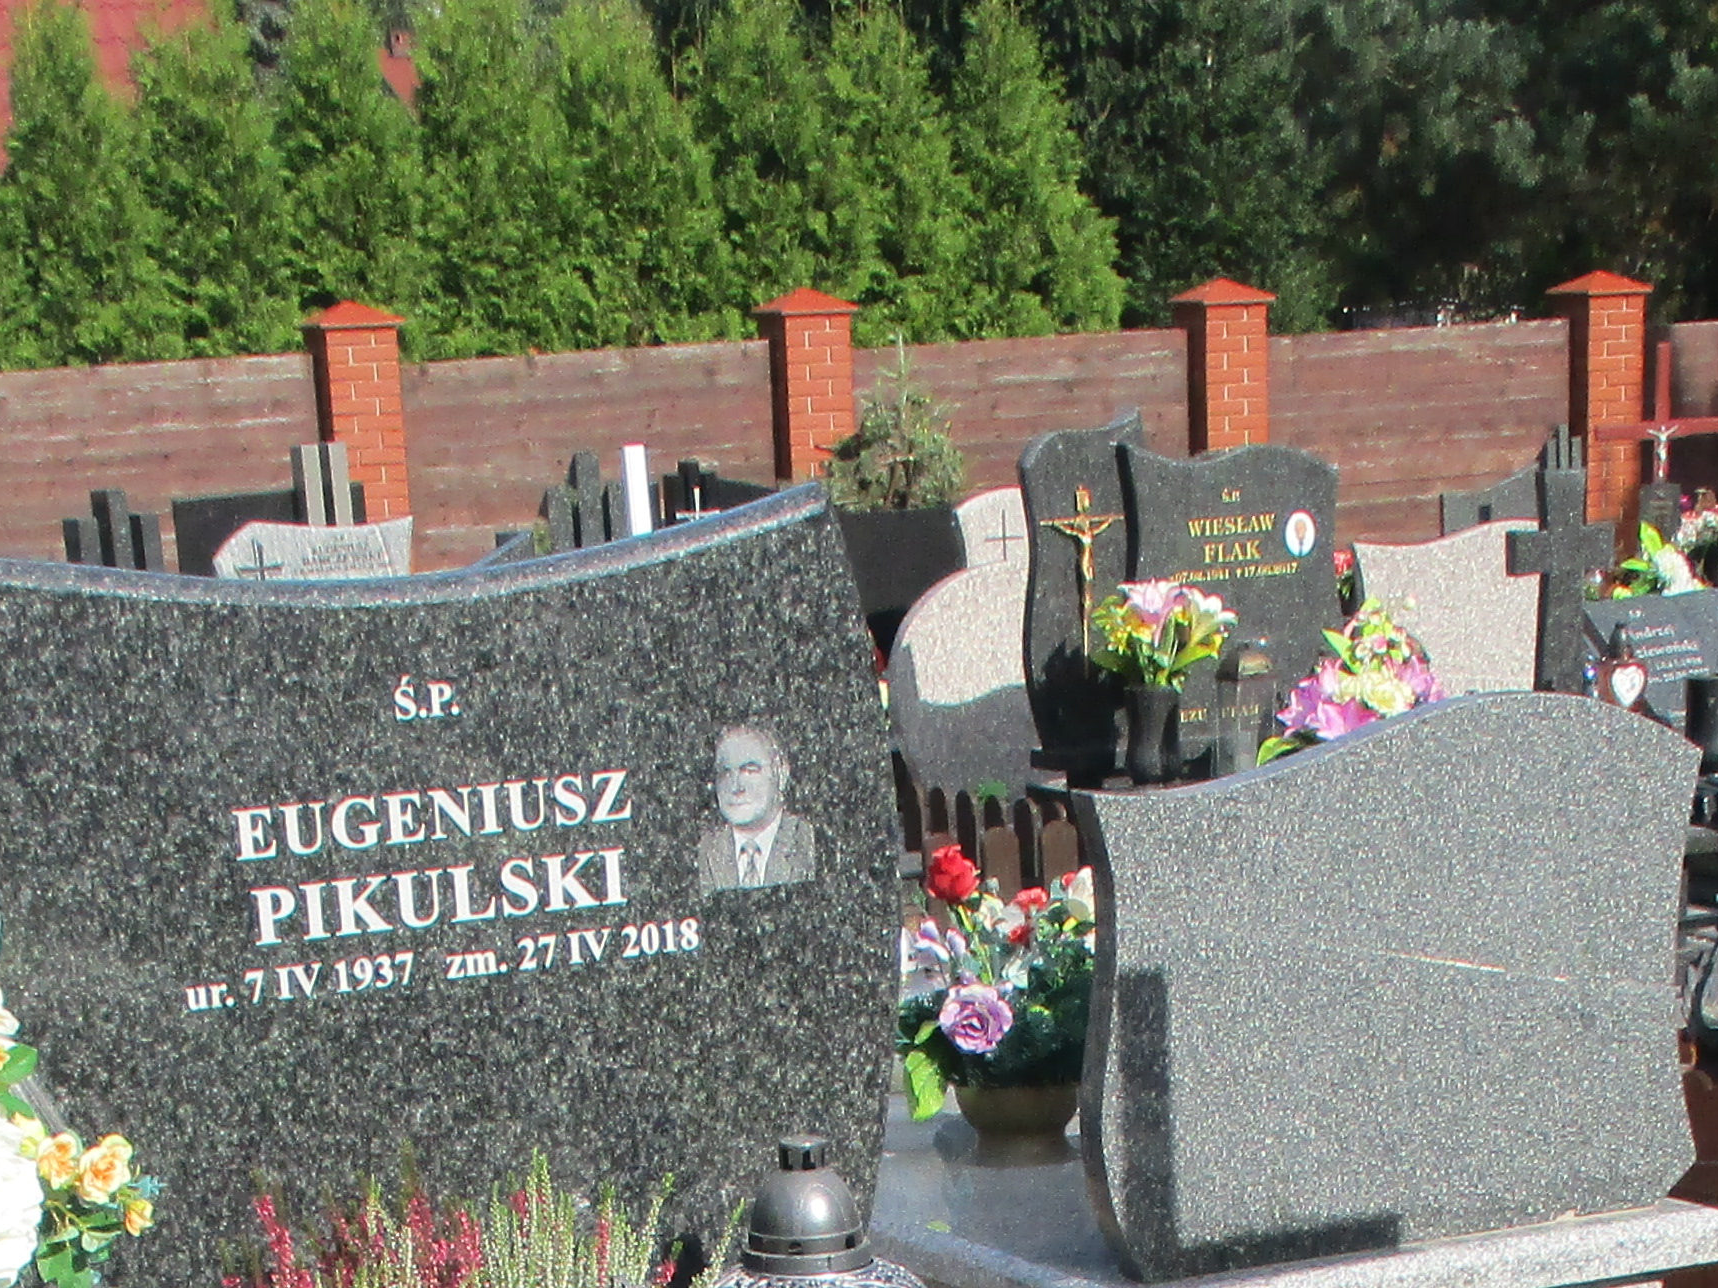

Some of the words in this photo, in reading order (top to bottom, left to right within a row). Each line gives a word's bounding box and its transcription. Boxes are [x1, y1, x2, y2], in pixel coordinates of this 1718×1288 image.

[1187, 512, 1276, 537] WIESŁAW
[1203, 539, 1263, 563] FLAK
[393, 675, 461, 721] Ś.P.
[232, 769, 632, 861] EUGENIUSZ
[251, 846, 628, 945] PIKULSKI
[186, 980, 235, 1012] ur.
[245, 968, 264, 999] 7
[277, 960, 320, 999] IV
[334, 952, 414, 993] 1937
[446, 945, 509, 981] zm.
[517, 935, 560, 973] 27
[567, 928, 610, 967] IV
[621, 918, 700, 960] 2018
